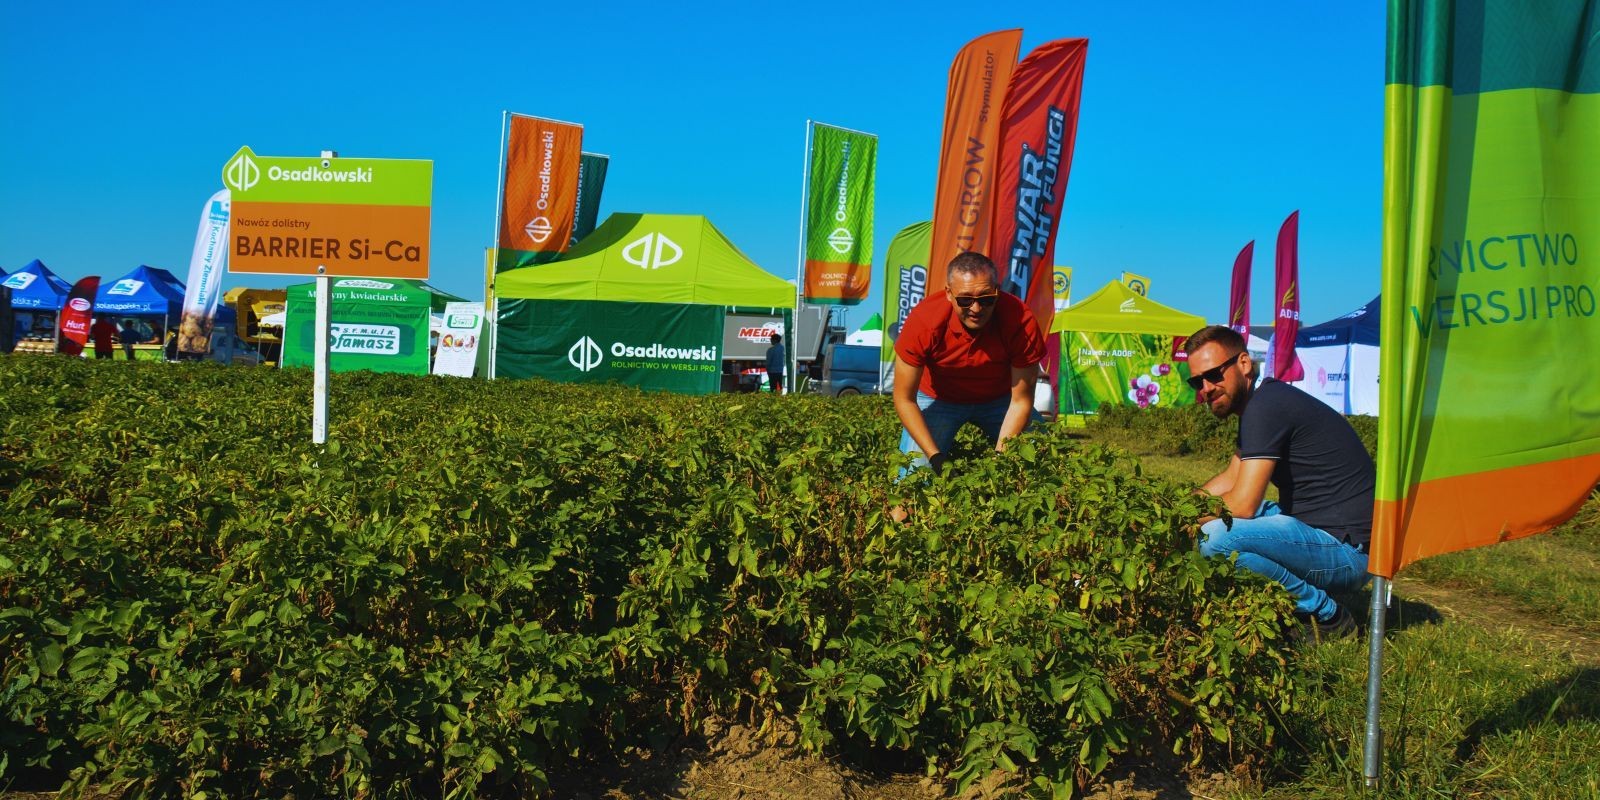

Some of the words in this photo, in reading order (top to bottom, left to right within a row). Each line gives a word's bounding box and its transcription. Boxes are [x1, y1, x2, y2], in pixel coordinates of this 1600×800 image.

[979, 50, 994, 123] Stymulator
[268, 166, 373, 183] Osadkowski
[537, 131, 554, 210] Osadkowski
[835, 141, 850, 222] Osadkowski
[959, 137, 985, 228] GROW
[237, 218, 270, 227] Nawóz
[272, 219, 310, 230] dolistny
[236, 235, 341, 259] BARRIER
[349, 239, 421, 262] Si-Ca
[351, 291, 408, 302] kwiaciarskie
[1545, 285, 1596, 318] PRO
[739, 328, 776, 337] MEGA
[611, 342, 716, 360] Osadkowski
[611, 361, 659, 369] ROLNICTWO
